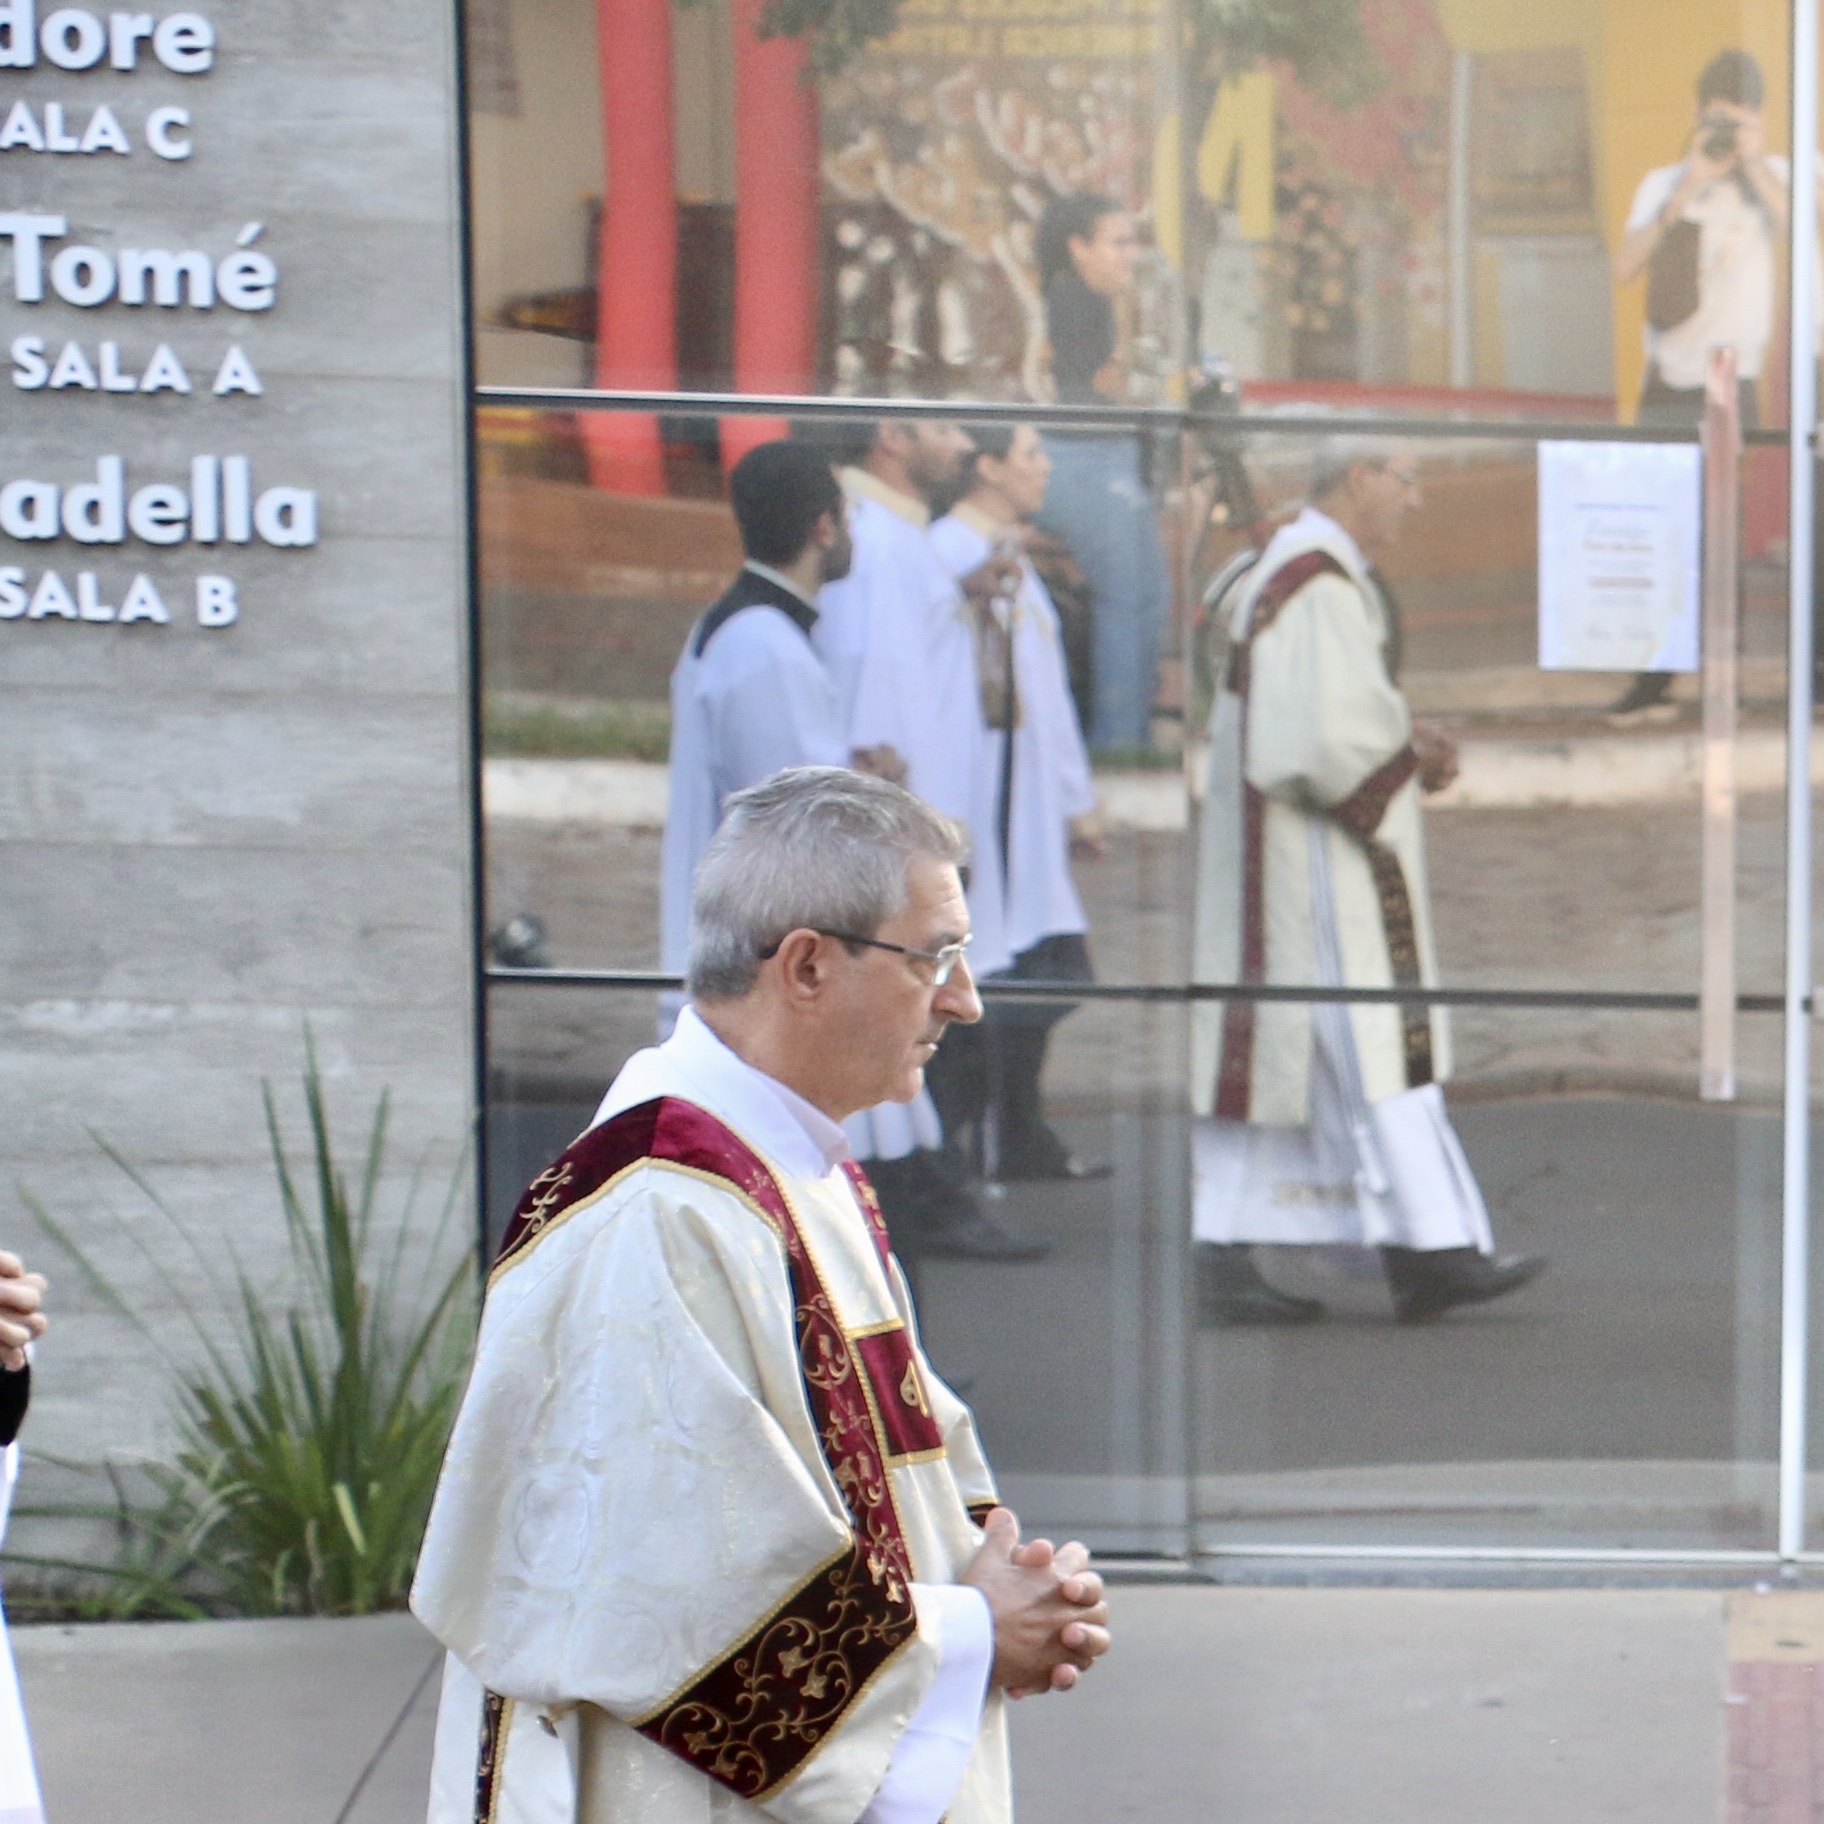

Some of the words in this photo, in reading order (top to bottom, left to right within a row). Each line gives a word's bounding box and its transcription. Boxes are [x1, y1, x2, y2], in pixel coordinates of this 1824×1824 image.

[146, 105, 194, 160] C
[0, 212, 279, 311] Tomé
[11, 334, 193, 393] SALA
[211, 343, 264, 395] A
[0, 453, 319, 546] adella
[0, 565, 171, 624] SALA
[196, 574, 239, 626] B
